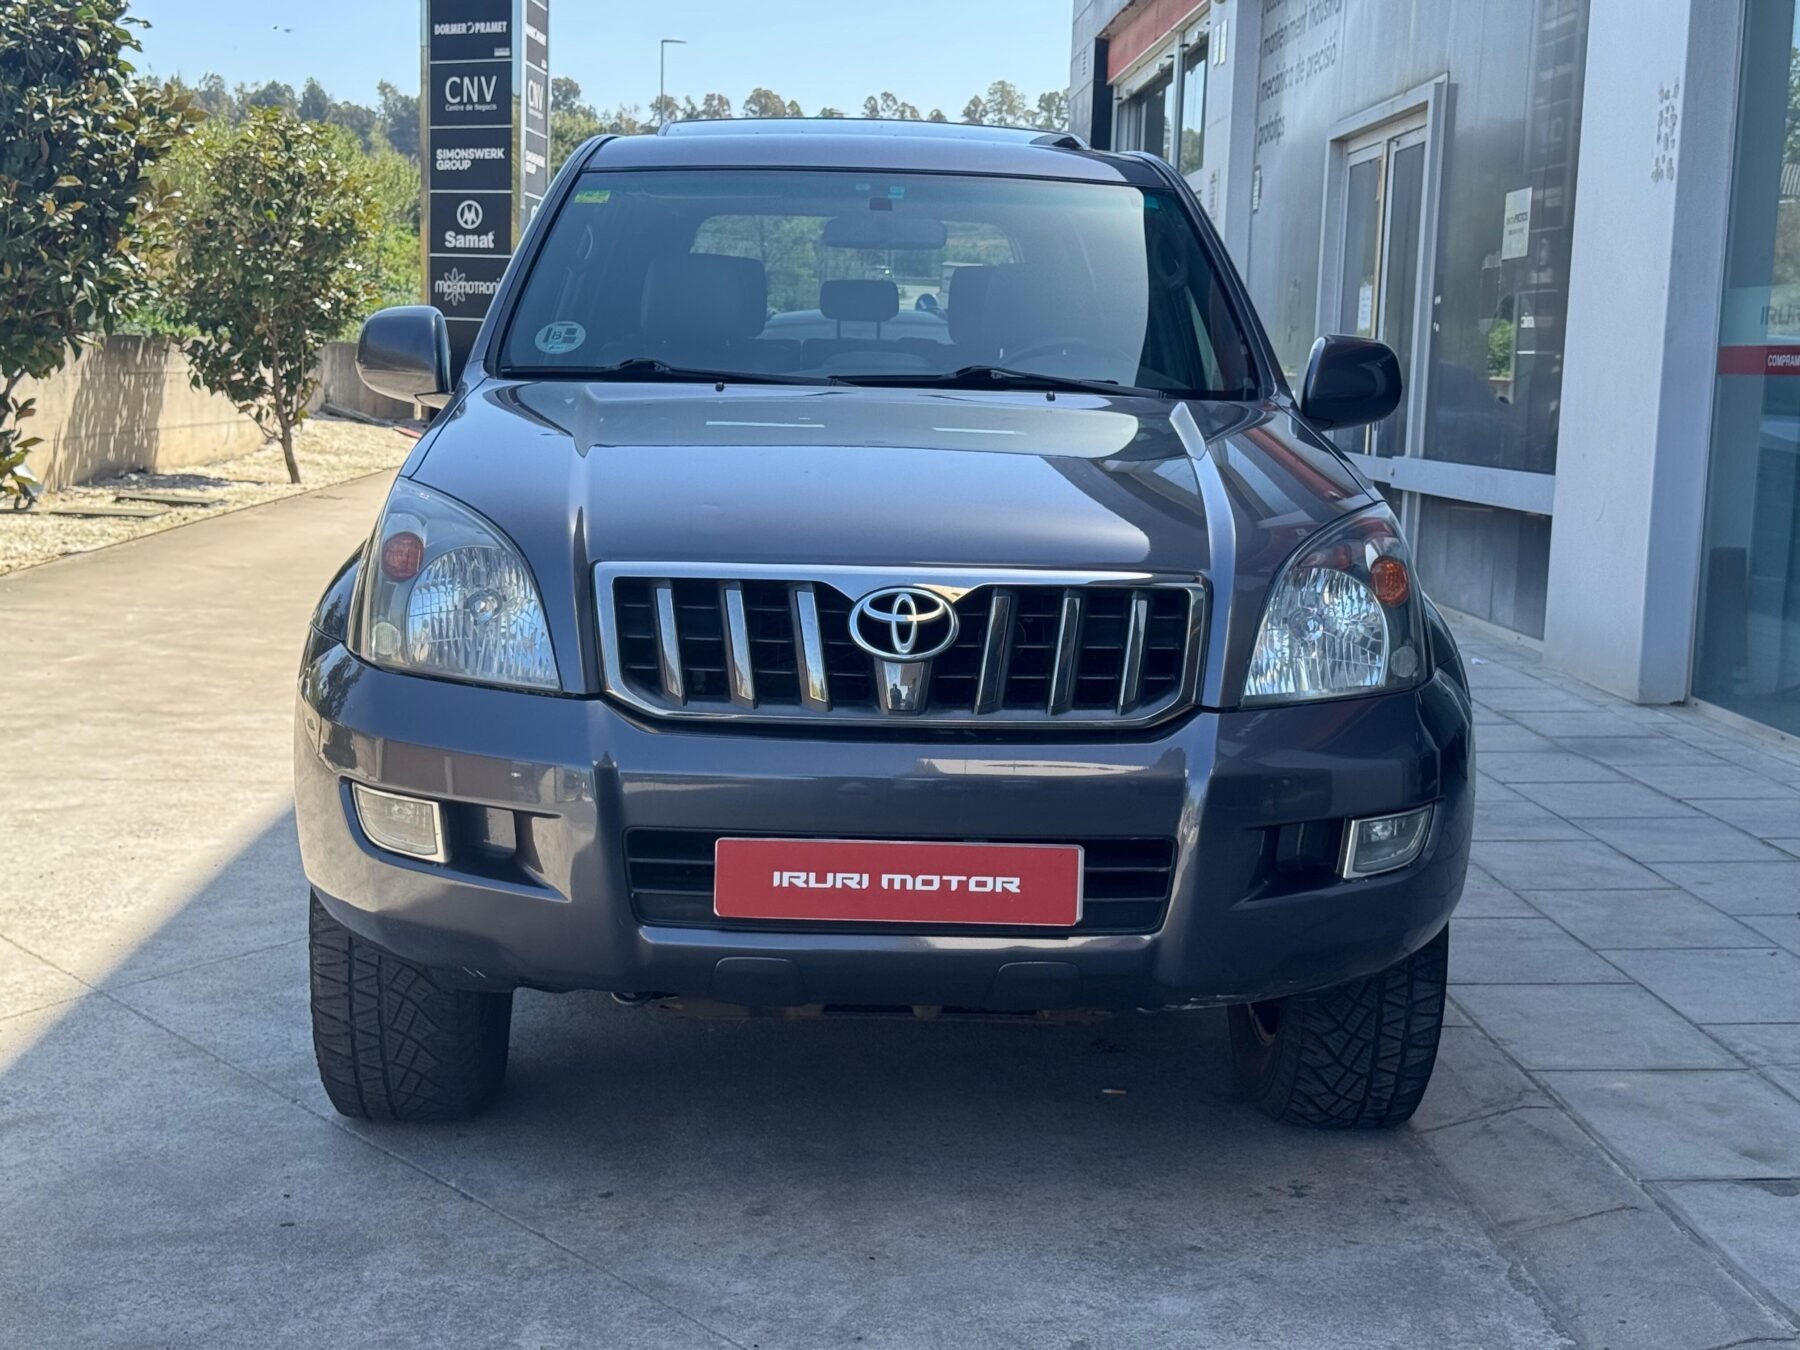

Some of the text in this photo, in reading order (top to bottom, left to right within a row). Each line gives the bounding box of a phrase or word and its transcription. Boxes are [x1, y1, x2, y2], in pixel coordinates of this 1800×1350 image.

[434, 21, 507, 35] DORMER PRAMET
[445, 76, 497, 103] CNV
[436, 148, 505, 160] SIMONSWERK
[436, 160, 472, 170] GROUP
[773, 871, 1021, 893] IRURI MOTOR
